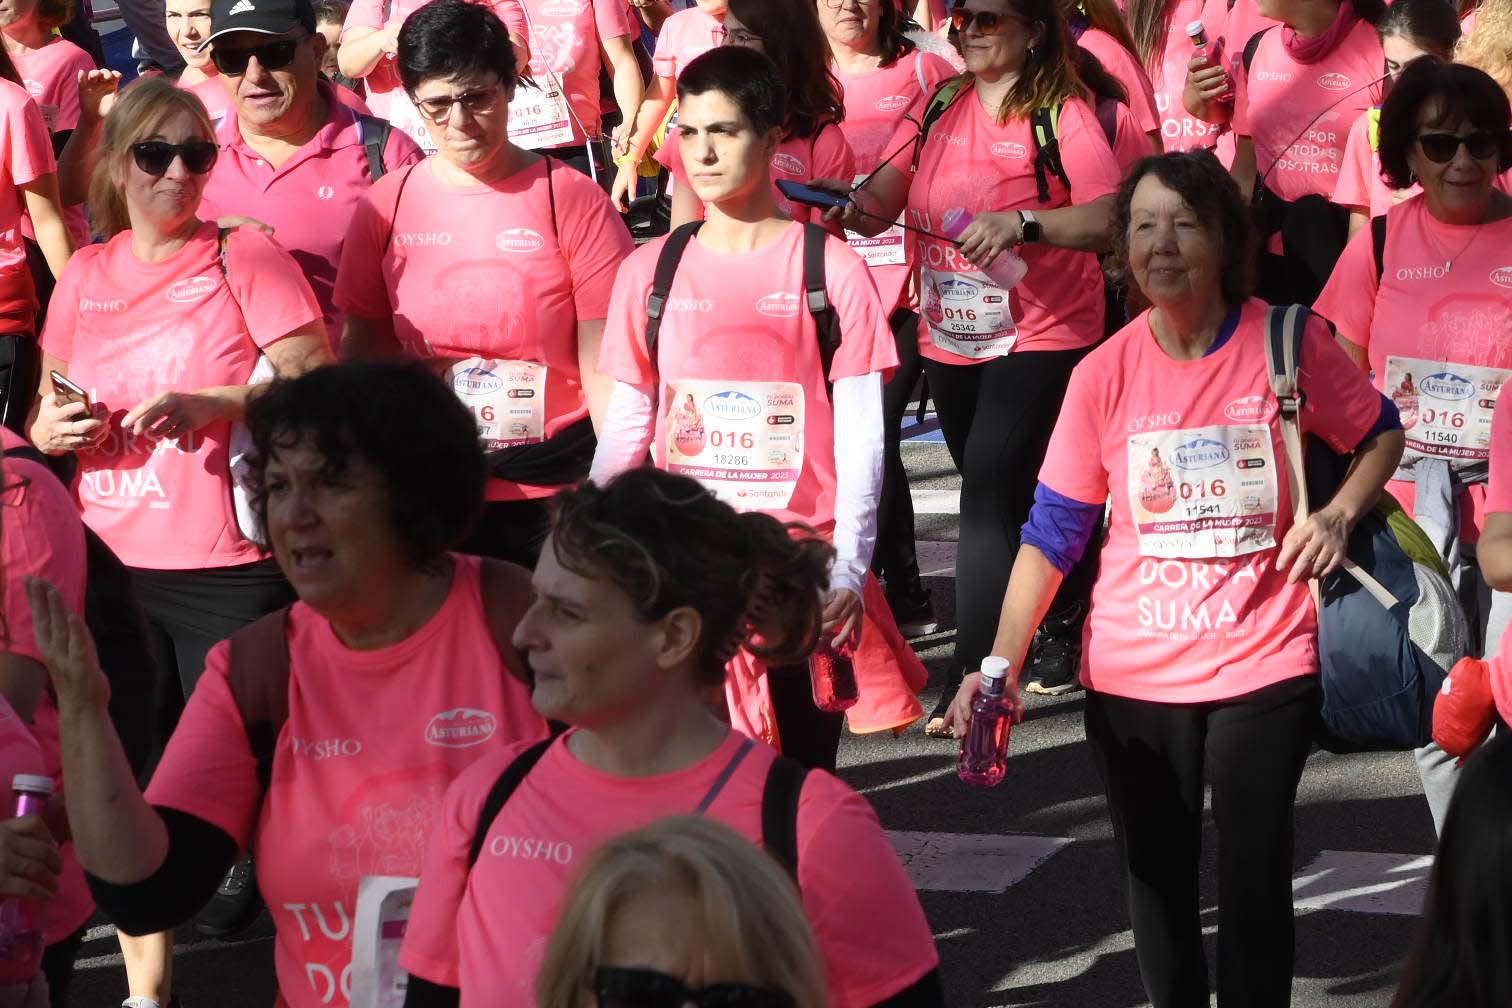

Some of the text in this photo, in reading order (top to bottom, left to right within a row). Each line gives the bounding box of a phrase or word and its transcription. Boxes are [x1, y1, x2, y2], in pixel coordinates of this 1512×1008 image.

[1309, 131, 1337, 143] POR
[1293, 145, 1338, 159] TODAS
[910, 209, 931, 232] TU
[394, 231, 452, 248] OYSHO
[1396, 266, 1445, 282] OYSHO
[945, 307, 977, 321] 016
[951, 323, 976, 332] 25342
[1128, 411, 1182, 432] OYSHO
[1422, 408, 1465, 428] 016
[710, 430, 754, 449] 016
[1425, 430, 1458, 444] 11540
[1233, 442, 1262, 451] SUMA
[1449, 448, 1475, 457] MUJER
[714, 453, 749, 466] 18286
[1175, 450, 1226, 464] ASTURIANA
[739, 472, 768, 480] MUJER
[1180, 479, 1226, 500] 016
[1185, 504, 1221, 517] 11541
[1138, 598, 1239, 630] SUMA
[429, 723, 497, 741] ASTURIANA
[489, 833, 575, 866] OYSHO
